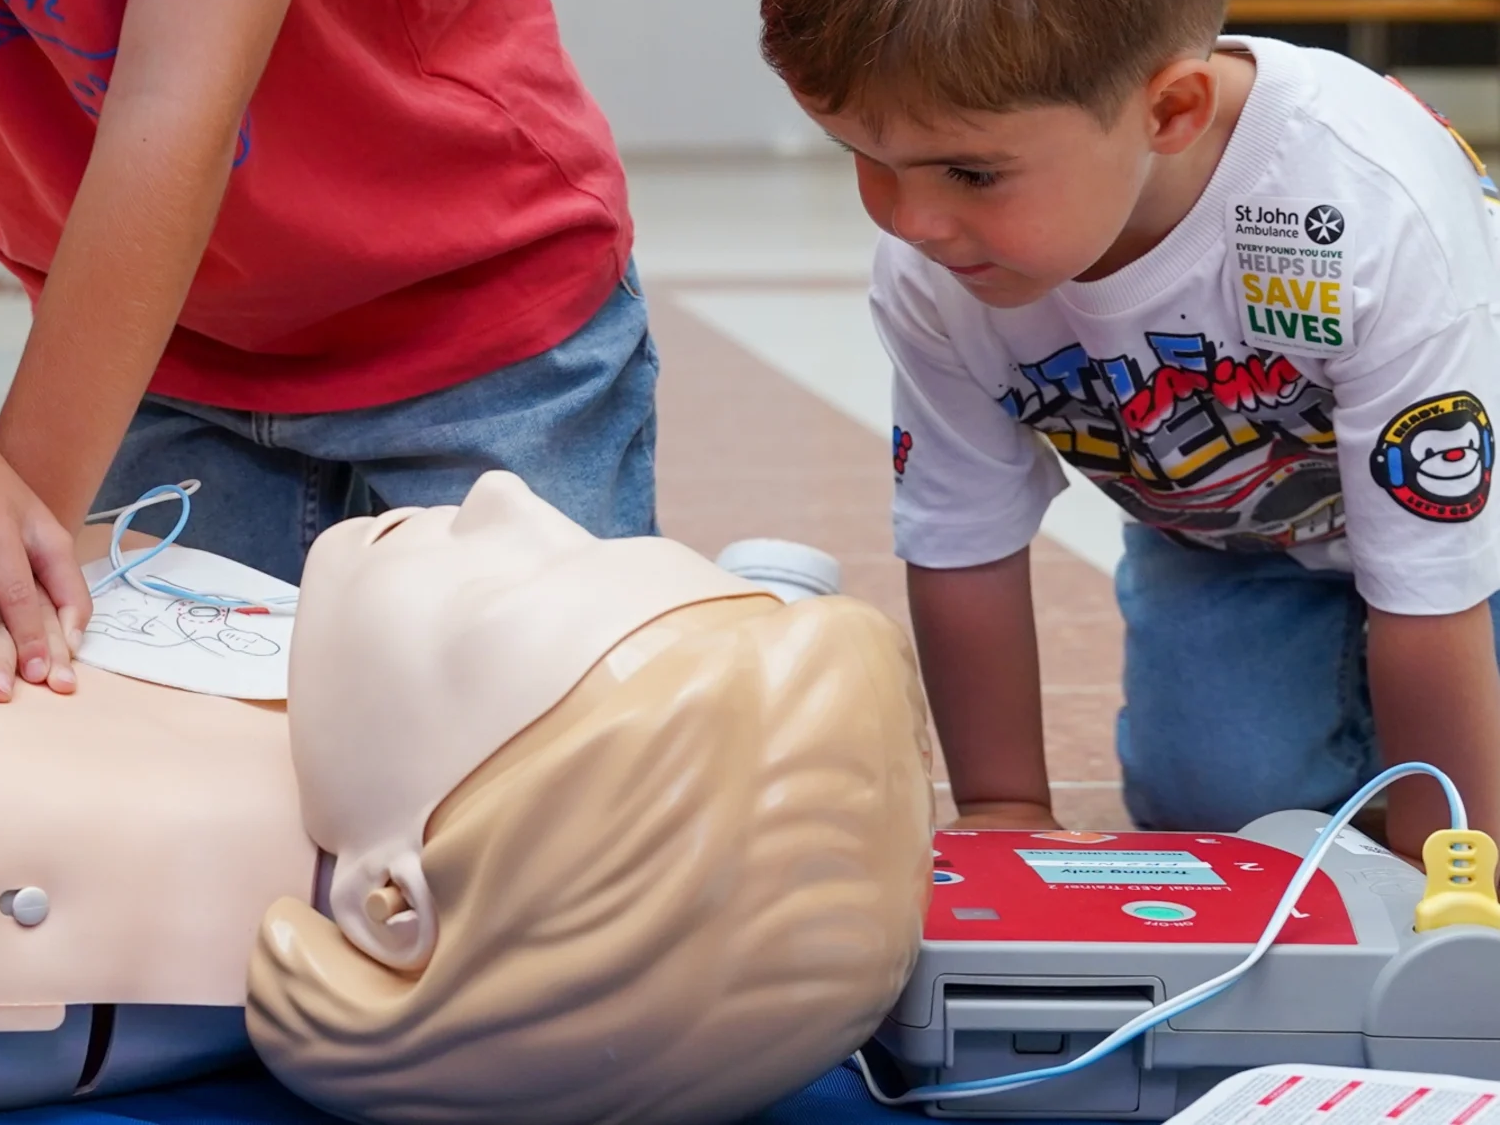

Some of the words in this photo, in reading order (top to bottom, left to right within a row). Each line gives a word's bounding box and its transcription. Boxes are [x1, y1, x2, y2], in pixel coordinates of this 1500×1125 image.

[1235, 205, 1251, 222] St
[1256, 206, 1299, 225] John
[1235, 223, 1299, 238] Ambulance
[1236, 243, 1264, 252] EVERY
[1265, 245, 1297, 256] POUND
[1299, 248, 1318, 257] YOU
[1320, 250, 1343, 259] GIVE
[1237, 252, 1305, 276] HELPS
[1311, 259, 1342, 279] US
[1242, 272, 1341, 315] SAVE
[1247, 304, 1343, 347] LIVES
